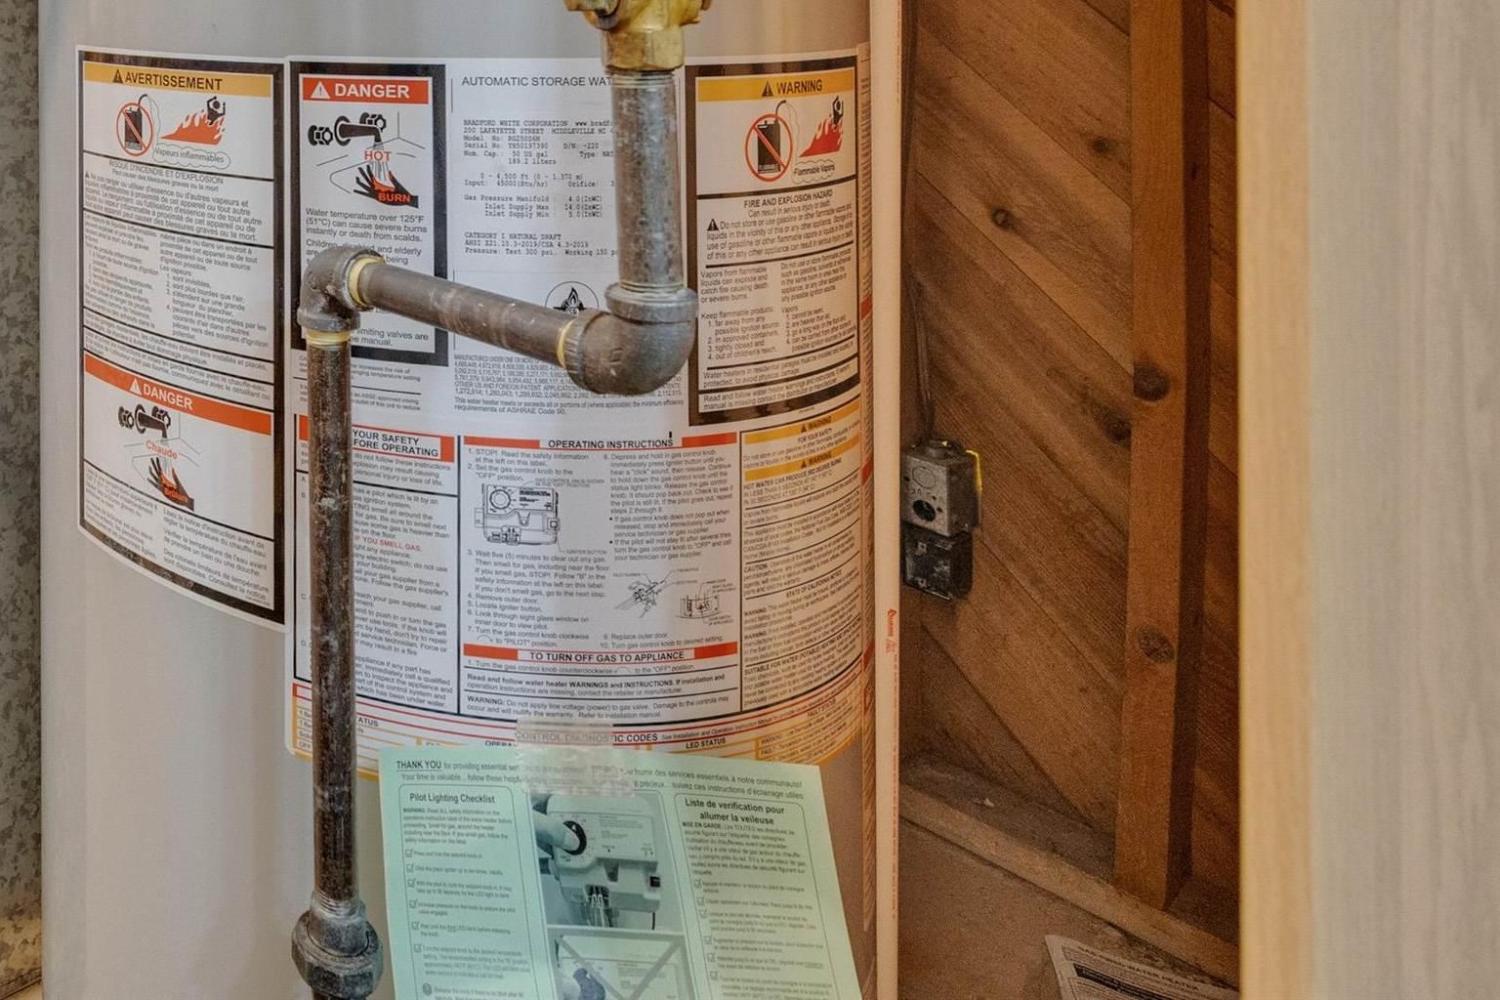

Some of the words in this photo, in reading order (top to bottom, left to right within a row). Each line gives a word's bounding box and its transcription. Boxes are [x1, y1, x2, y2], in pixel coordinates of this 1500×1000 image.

[125, 73, 223, 91] AVERTISSEMENT
[462, 76, 529, 87] AUTOMATIC
[532, 77, 586, 87] STORAGE
[588, 76, 612, 87] WAT
[777, 79, 823, 95] WARNING
[334, 82, 410, 99] DANGER
[155, 149, 179, 158] Vapeurs
[179, 151, 224, 163] inflammables
[364, 151, 392, 161] HOT
[165, 170, 174, 178] ET
[175, 171, 224, 184] D'EXPLOSION
[378, 193, 411, 202] BURN
[744, 199, 760, 208] FIRE
[761, 198, 777, 206] AND
[778, 193, 812, 205] EXPLOSION
[306, 208, 328, 216] Water
[330, 210, 377, 221] temperature
[400, 215, 425, 223] 125°F
[332, 219, 346, 227] can
[348, 221, 373, 229] cause
[375, 222, 402, 231] severe
[306, 228, 337, 237] instantly
[349, 230, 371, 238] death
[393, 234, 422, 242] scalds.
[387, 330, 413, 340] valves
[415, 333, 429, 341] are
[361, 338, 393, 346] manual.
[143, 383, 193, 410] DANGER
[353, 429, 379, 440] YOUR
[382, 434, 419, 445] SAFETY
[382, 443, 439, 457] OPERATING
[548, 440, 604, 449] OPERATING
[606, 439, 674, 448] INSTRUCTIONS
[362, 536, 378, 545] YOU
[379, 538, 403, 548] SMELL
[530, 652, 543, 660] TO
[546, 652, 573, 662] TURN
[575, 653, 594, 662] OFF
[596, 653, 618, 663] GAS
[619, 653, 632, 662] TO
[634, 651, 684, 662] APPLIANCE
[626, 734, 658, 743] CODES
[686, 741, 698, 749] LED
[700, 737, 726, 748] STATUS
[396, 760, 424, 770] THANK
[425, 760, 442, 769] YOU
[410, 793, 427, 802] Pilot
[428, 793, 459, 804] Lighting
[460, 794, 495, 804] Checklist
[685, 798, 705, 808] Liste
[707, 800, 718, 808] de
[766, 806, 785, 815] pour
[700, 811, 729, 823] allumer
[731, 814, 740, 822] la
